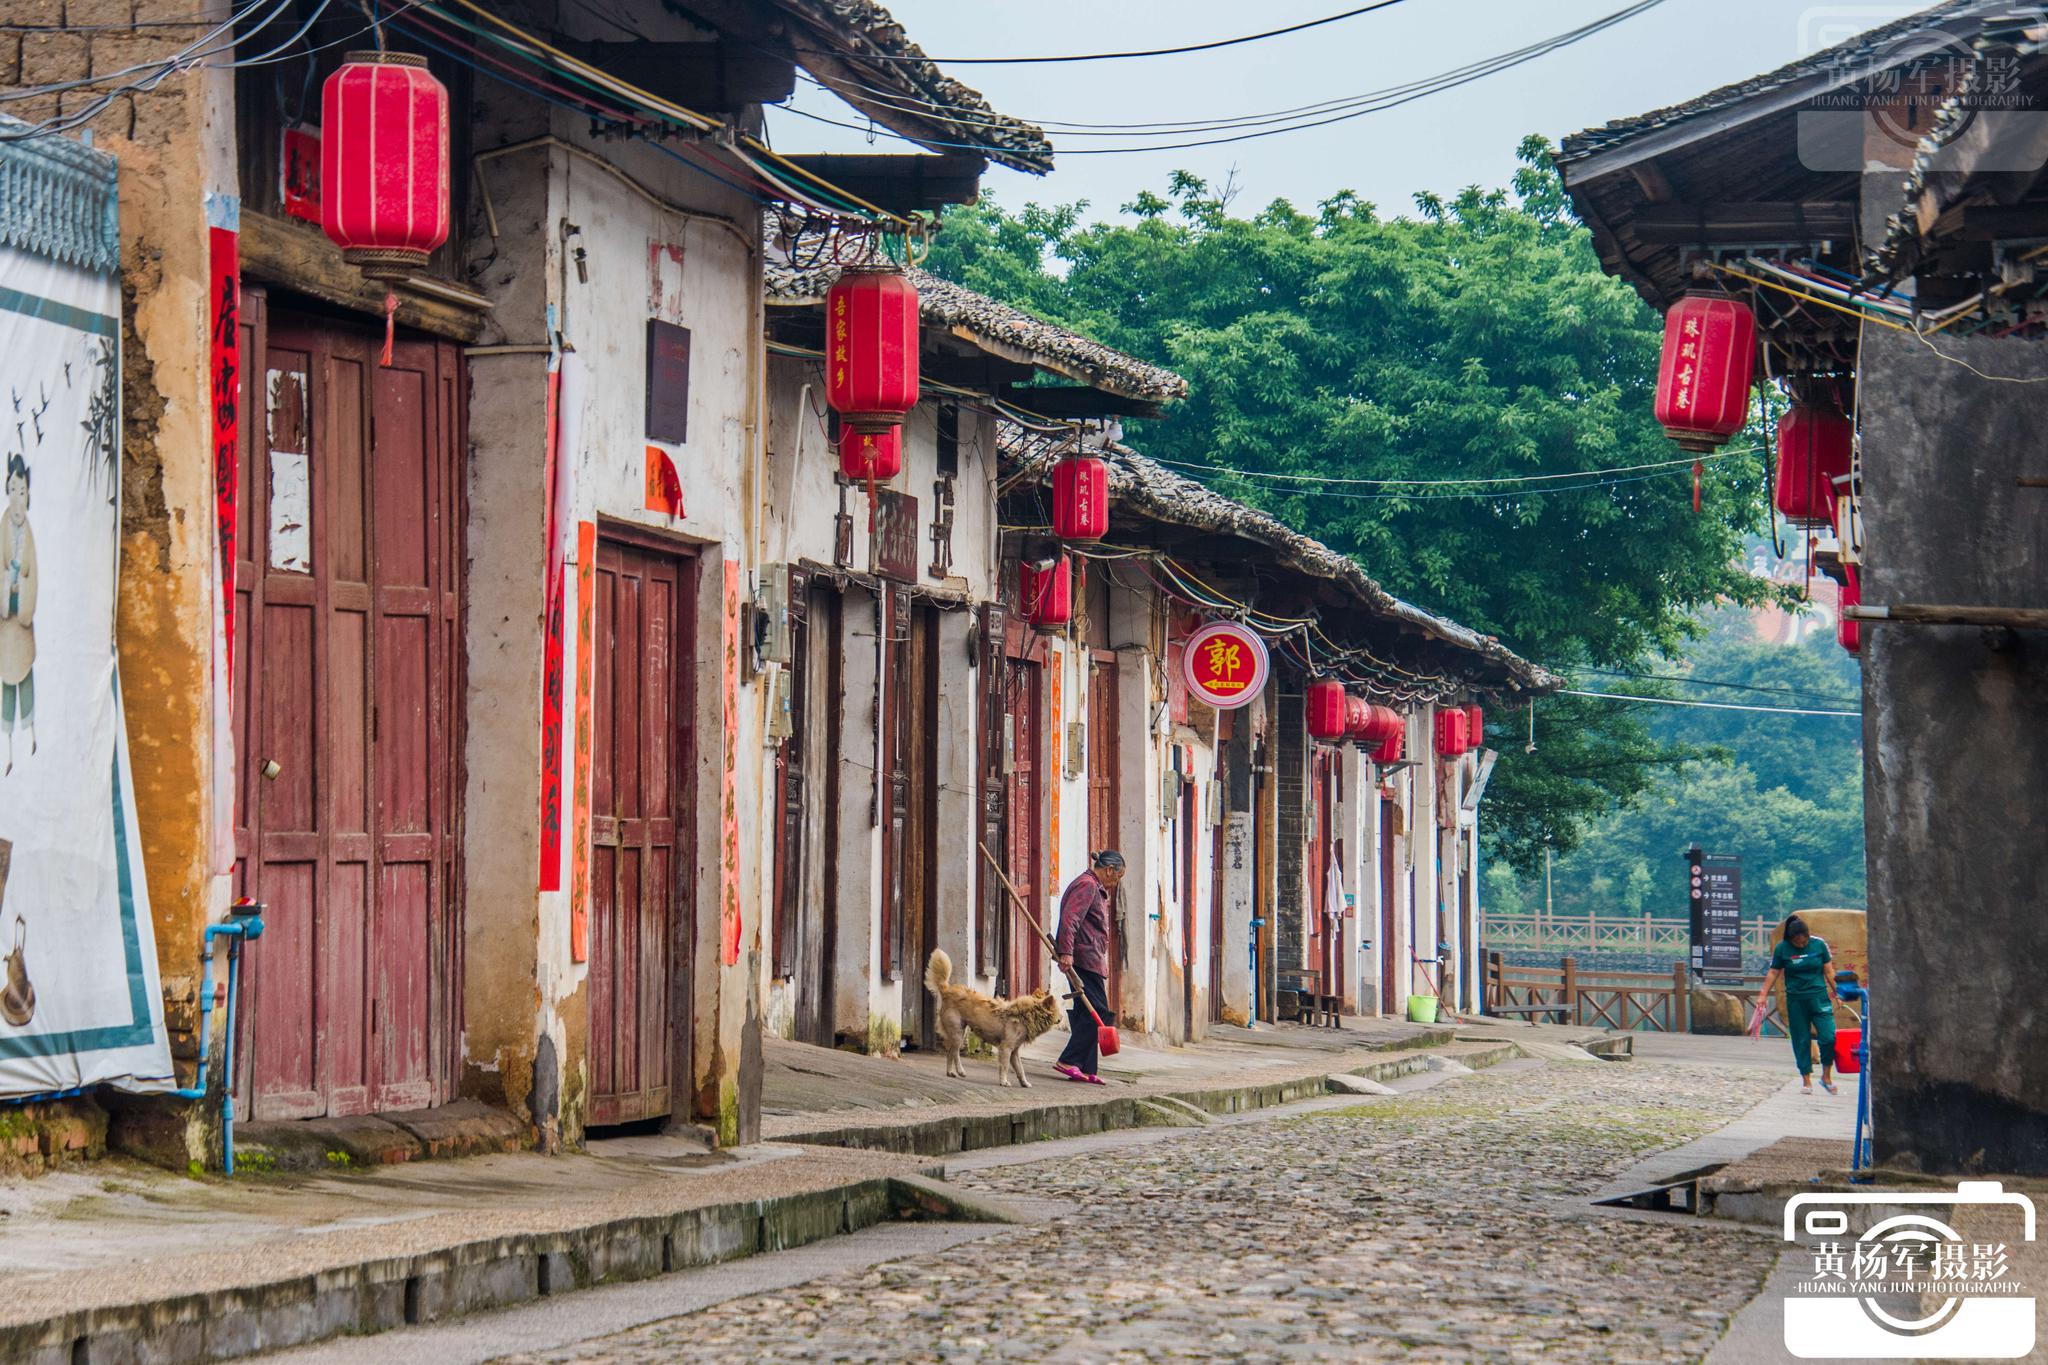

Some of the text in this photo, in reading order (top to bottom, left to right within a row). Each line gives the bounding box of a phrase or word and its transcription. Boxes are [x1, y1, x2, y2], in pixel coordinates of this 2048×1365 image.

[834, 295, 848, 389] 吾家故乡
[1676, 317, 1700, 409] 珠玑古巷
[1079, 471, 1090, 526] 珠玑古巷
[1204, 639, 1241, 681] 郭
